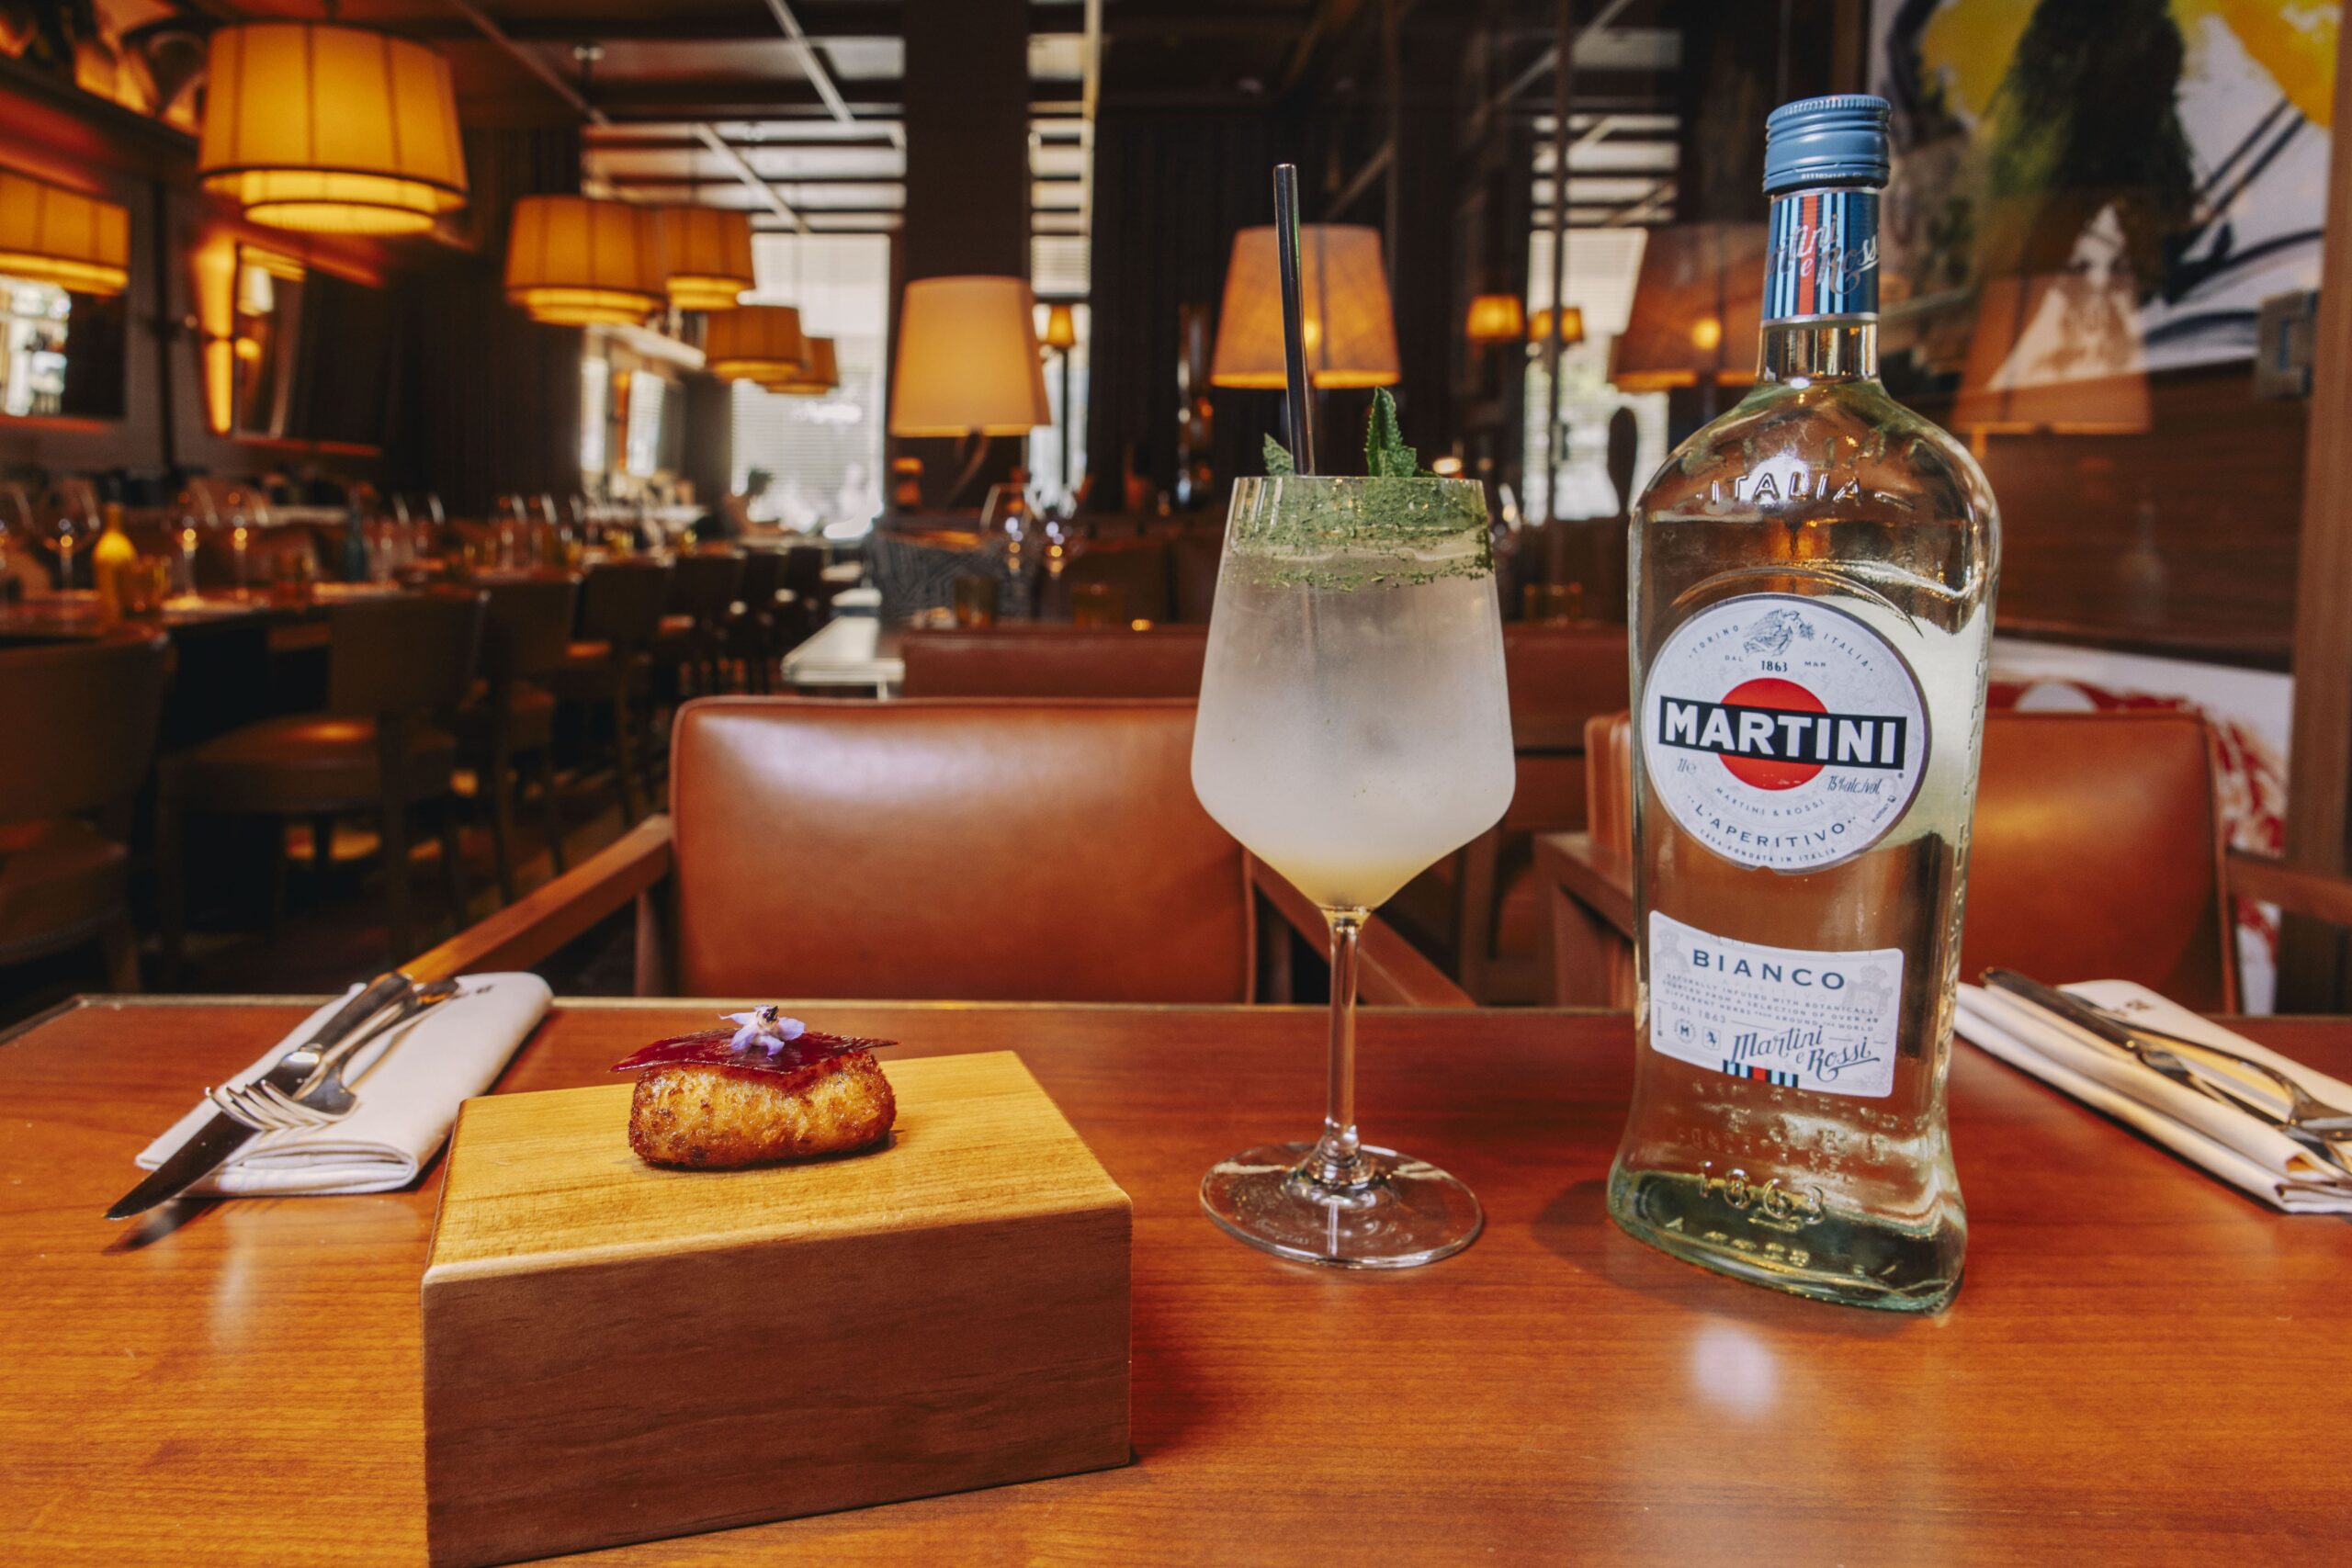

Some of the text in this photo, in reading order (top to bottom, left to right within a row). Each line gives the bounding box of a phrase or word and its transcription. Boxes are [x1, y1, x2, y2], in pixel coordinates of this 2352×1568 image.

[1712, 471, 1861, 506] ITALIA
[1692, 625, 1870, 667] TORINO ITALIA
[1724, 654, 1744, 662] DAL
[1760, 660, 1788, 672] 1863
[1664, 702, 1897, 765] MARTINI
[1715, 787, 1765, 816] MARTINI
[1786, 798, 1825, 816] ROSSI
[1695, 803, 1846, 848] L'APERITIVO
[1799, 848, 1837, 862] ITALIA
[1693, 949, 1845, 990] BIANCO
[1667, 974, 1873, 1015] NATURALLY INFUSED WITH BOTANICALS
[1671, 1002, 1726, 1024] DAL 1863
[1705, 992, 1731, 1002] FROM
[1747, 1001, 1806, 1016] SELECTION
[1831, 1013, 1860, 1021] OVER
[1720, 1004, 1750, 1015] HERBS
[1775, 1015, 1818, 1026] AROUND
[1838, 1023, 1873, 1032] WORLD
[1729, 1025, 1823, 1065] Martini
[1795, 1036, 1881, 1082] e Rossi
